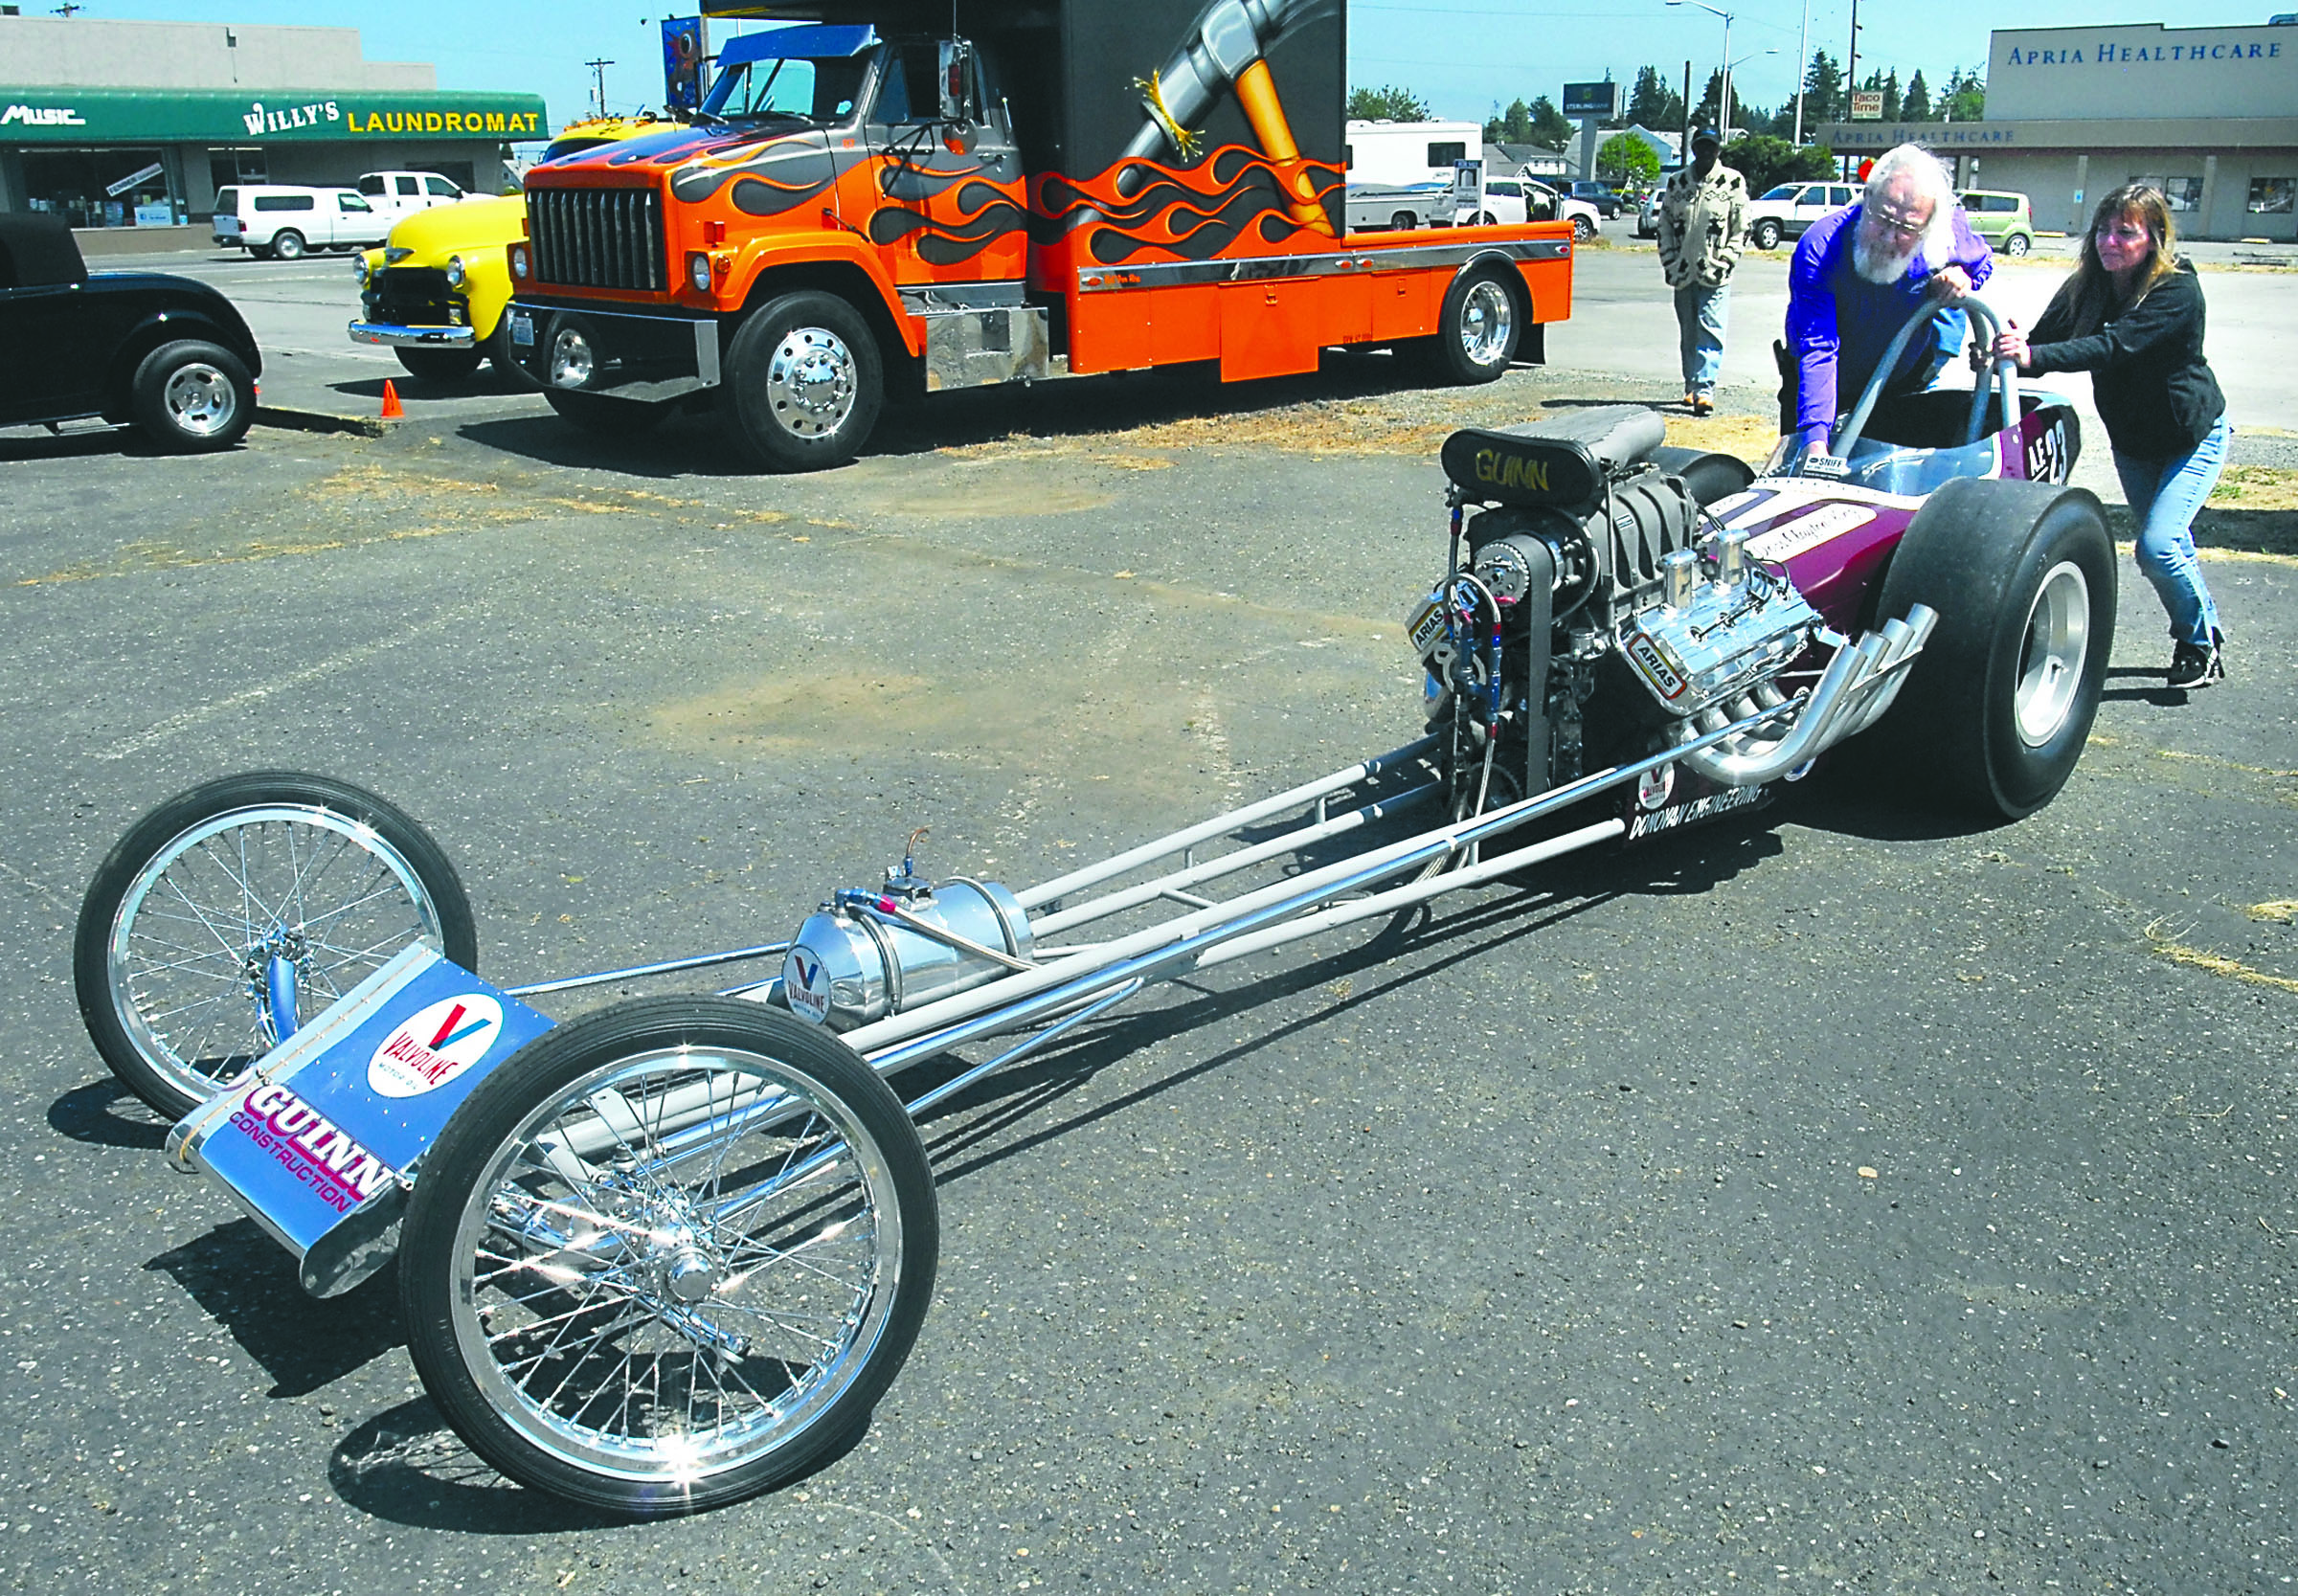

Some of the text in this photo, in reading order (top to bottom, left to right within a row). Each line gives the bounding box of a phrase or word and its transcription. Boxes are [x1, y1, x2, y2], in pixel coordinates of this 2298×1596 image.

[2008, 43, 2282, 65] APRIA HEALTHCARE
[1853, 93, 1881, 101] Taco
[1853, 102, 1880, 111] Time
[242, 101, 538, 136] WILLY'S LAUNDROMAT
[1832, 129, 2015, 144] APRIA HEALTHCARE
[1476, 448, 1549, 490] GUINN
[1819, 458, 1842, 467] SNIFF
[1415, 610, 1444, 645] ARIAS
[1638, 646, 1677, 687] ARIAS
[1684, 783, 1763, 823] ENGINEERING
[788, 980, 825, 1014] VALVOLINE
[383, 1031, 459, 1085] VALVOLINE
[244, 1085, 395, 1202] GUINN
[229, 1111, 351, 1213] CONSTRUCTION
